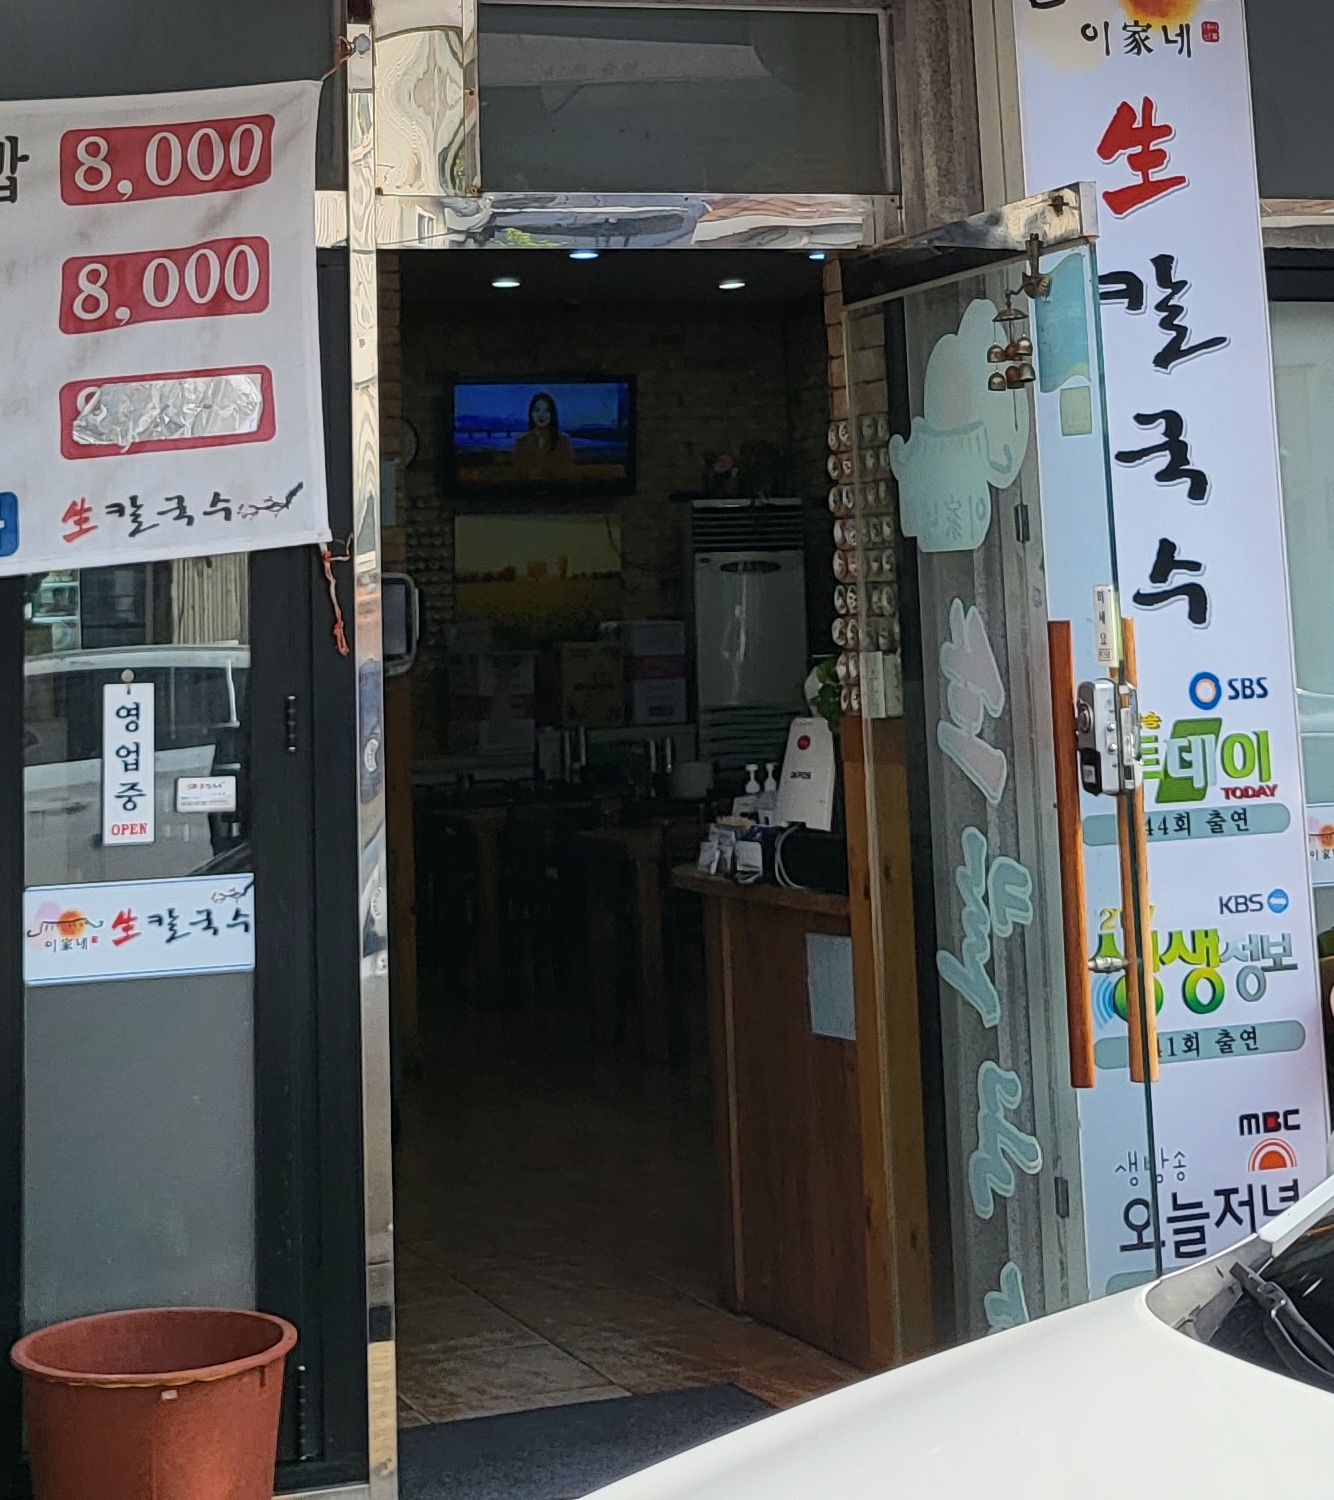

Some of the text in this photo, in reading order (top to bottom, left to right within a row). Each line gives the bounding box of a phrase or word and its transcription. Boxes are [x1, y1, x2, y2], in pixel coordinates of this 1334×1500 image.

[1080, 20, 1192, 58] 이家네
[74, 123, 264, 201] 8,000
[71, 244, 261, 325] 8,000
[1227, 677, 1269, 700] SBS
[114, 701, 147, 812] 영업중
[1220, 783, 1279, 800] TODAY
[111, 823, 148, 836] OPEN
[1205, 807, 1250, 833] 출연
[1219, 893, 1264, 915] KBS
[1157, 1026, 1260, 1057] 1회 출연
[1238, 1108, 1302, 1137] MBC
[1115, 1147, 1187, 1186] 생방송
